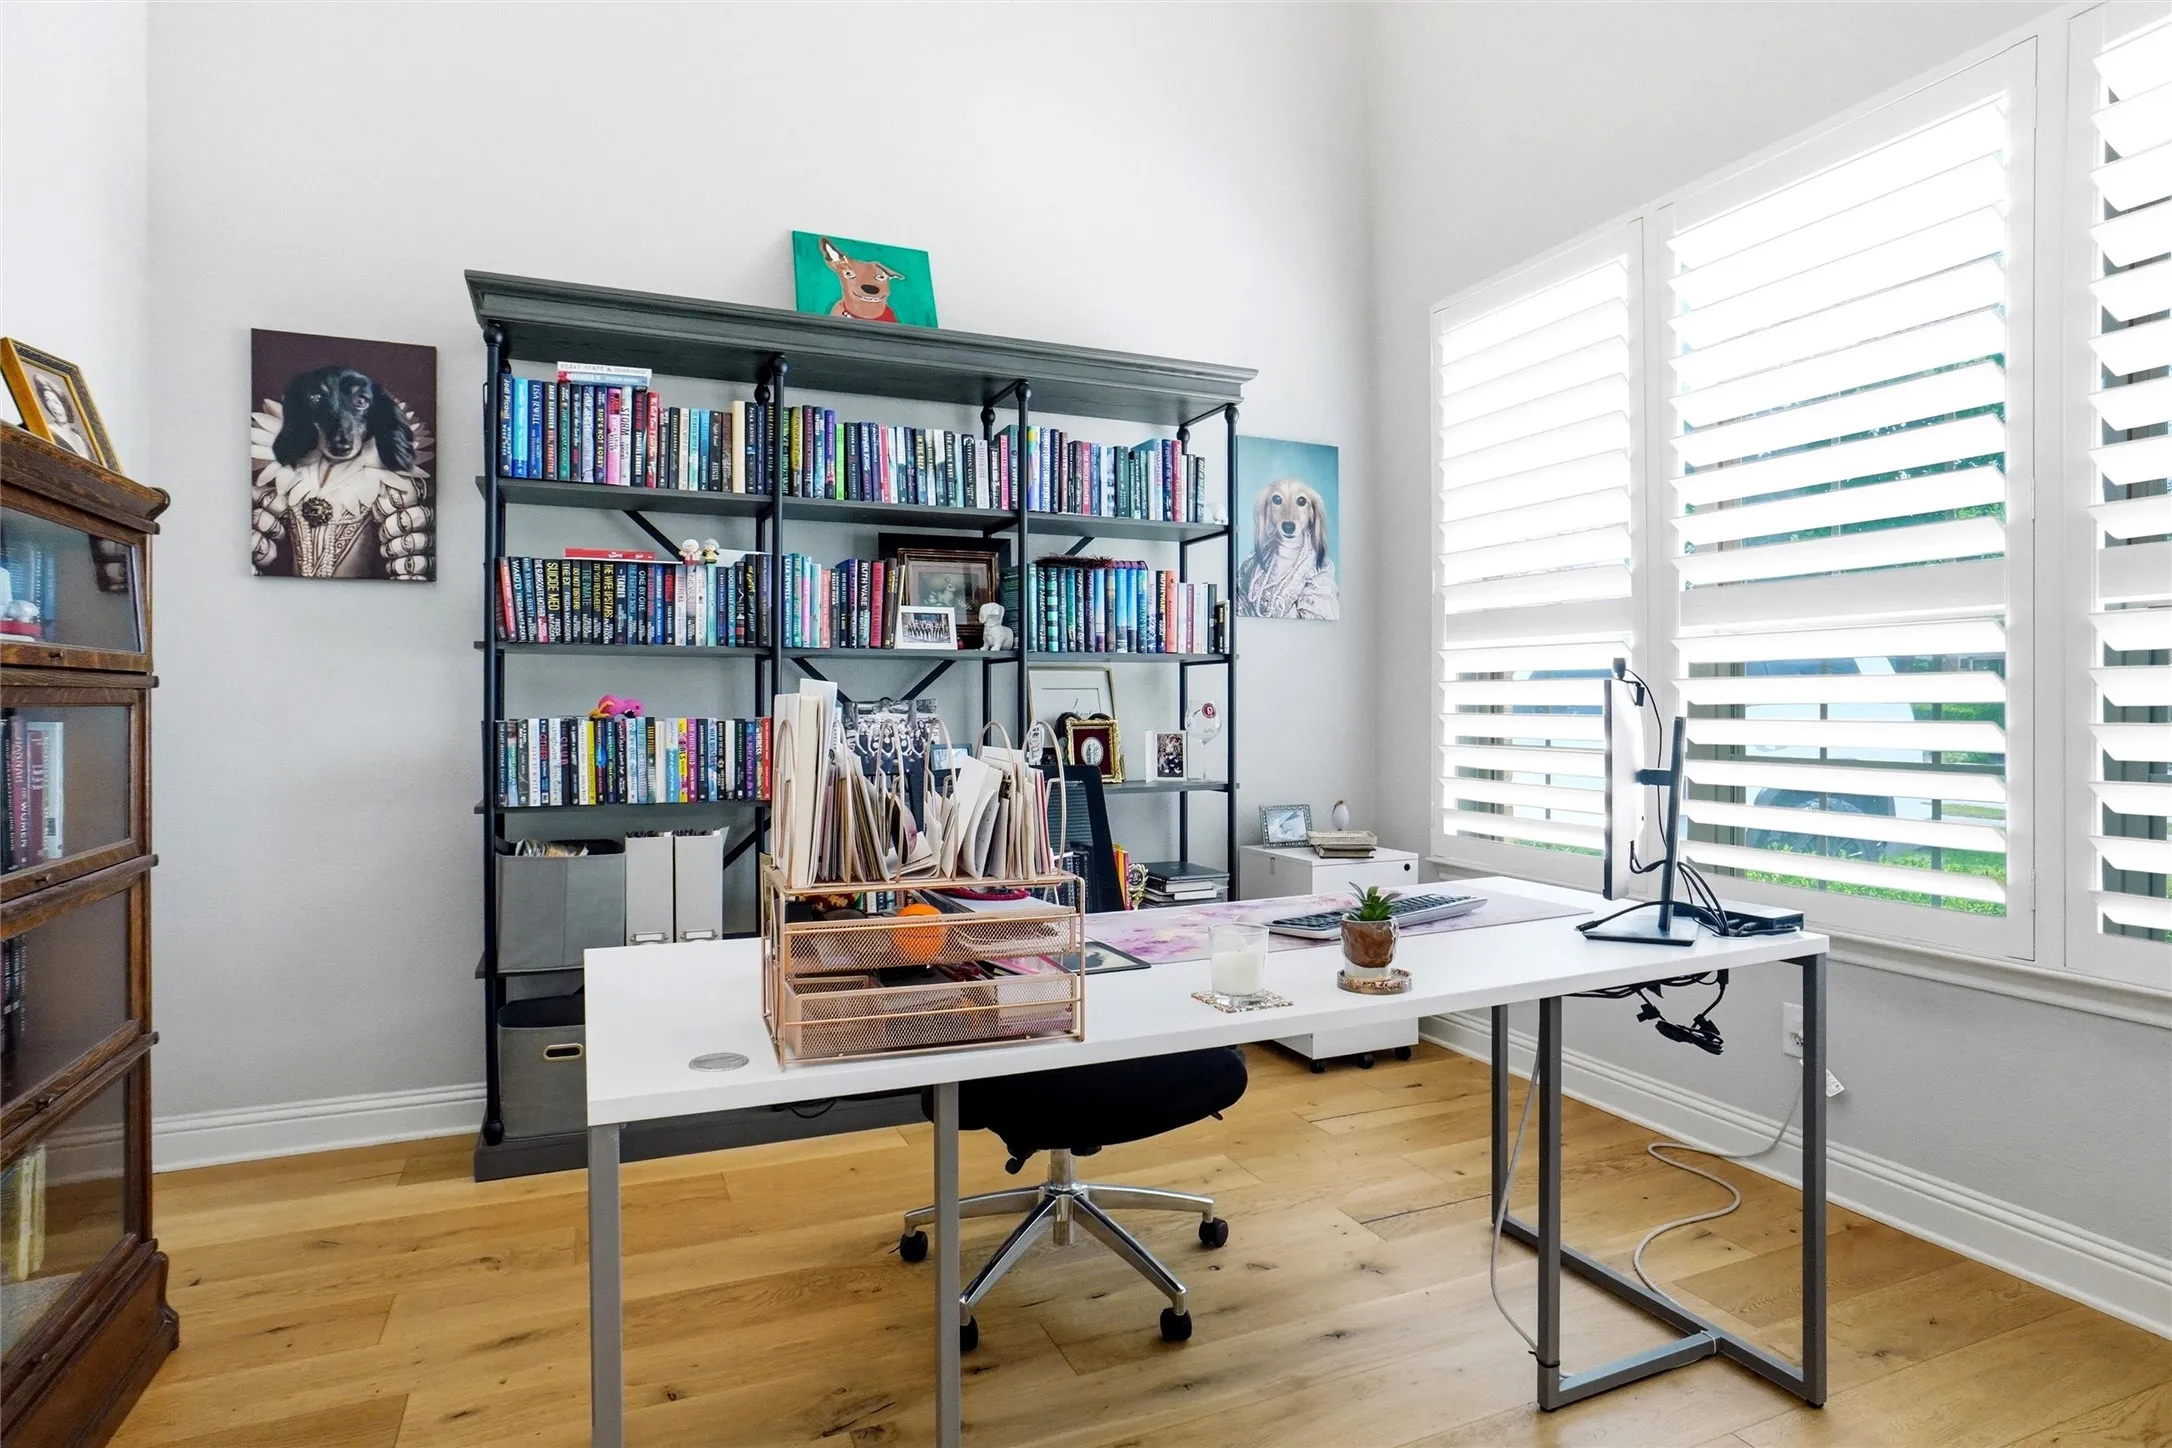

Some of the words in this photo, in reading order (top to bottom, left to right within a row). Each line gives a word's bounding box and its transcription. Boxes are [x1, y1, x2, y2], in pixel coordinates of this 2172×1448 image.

[532, 384, 540, 399] LISA
[503, 394, 511, 419] Picoult
[532, 400, 540, 425] JEWELL
[620, 407, 629, 436] STORM
[512, 560, 522, 583] WARD
[546, 562, 560, 591] SUICIDE
[562, 563, 571, 576] THE
[582, 569, 591, 581] THE
[603, 563, 614, 575] THE
[638, 570, 646, 586] ONE
[861, 562, 869, 584] RUTH
[572, 576, 580, 587] NOT
[603, 575, 614, 590] WIFE
[616, 574, 626, 598] TEACHER
[547, 593, 560, 611] MED
[603, 590, 614, 618] UPSTAIRS
[638, 596, 646, 612] ONE
[860, 585, 868, 606] WARE
[540, 733, 548, 760] OTHER
[560, 736, 569, 765] CLUB
[15, 736, 24, 784] HANNAH
[20, 801, 28, 849] WOMEN
